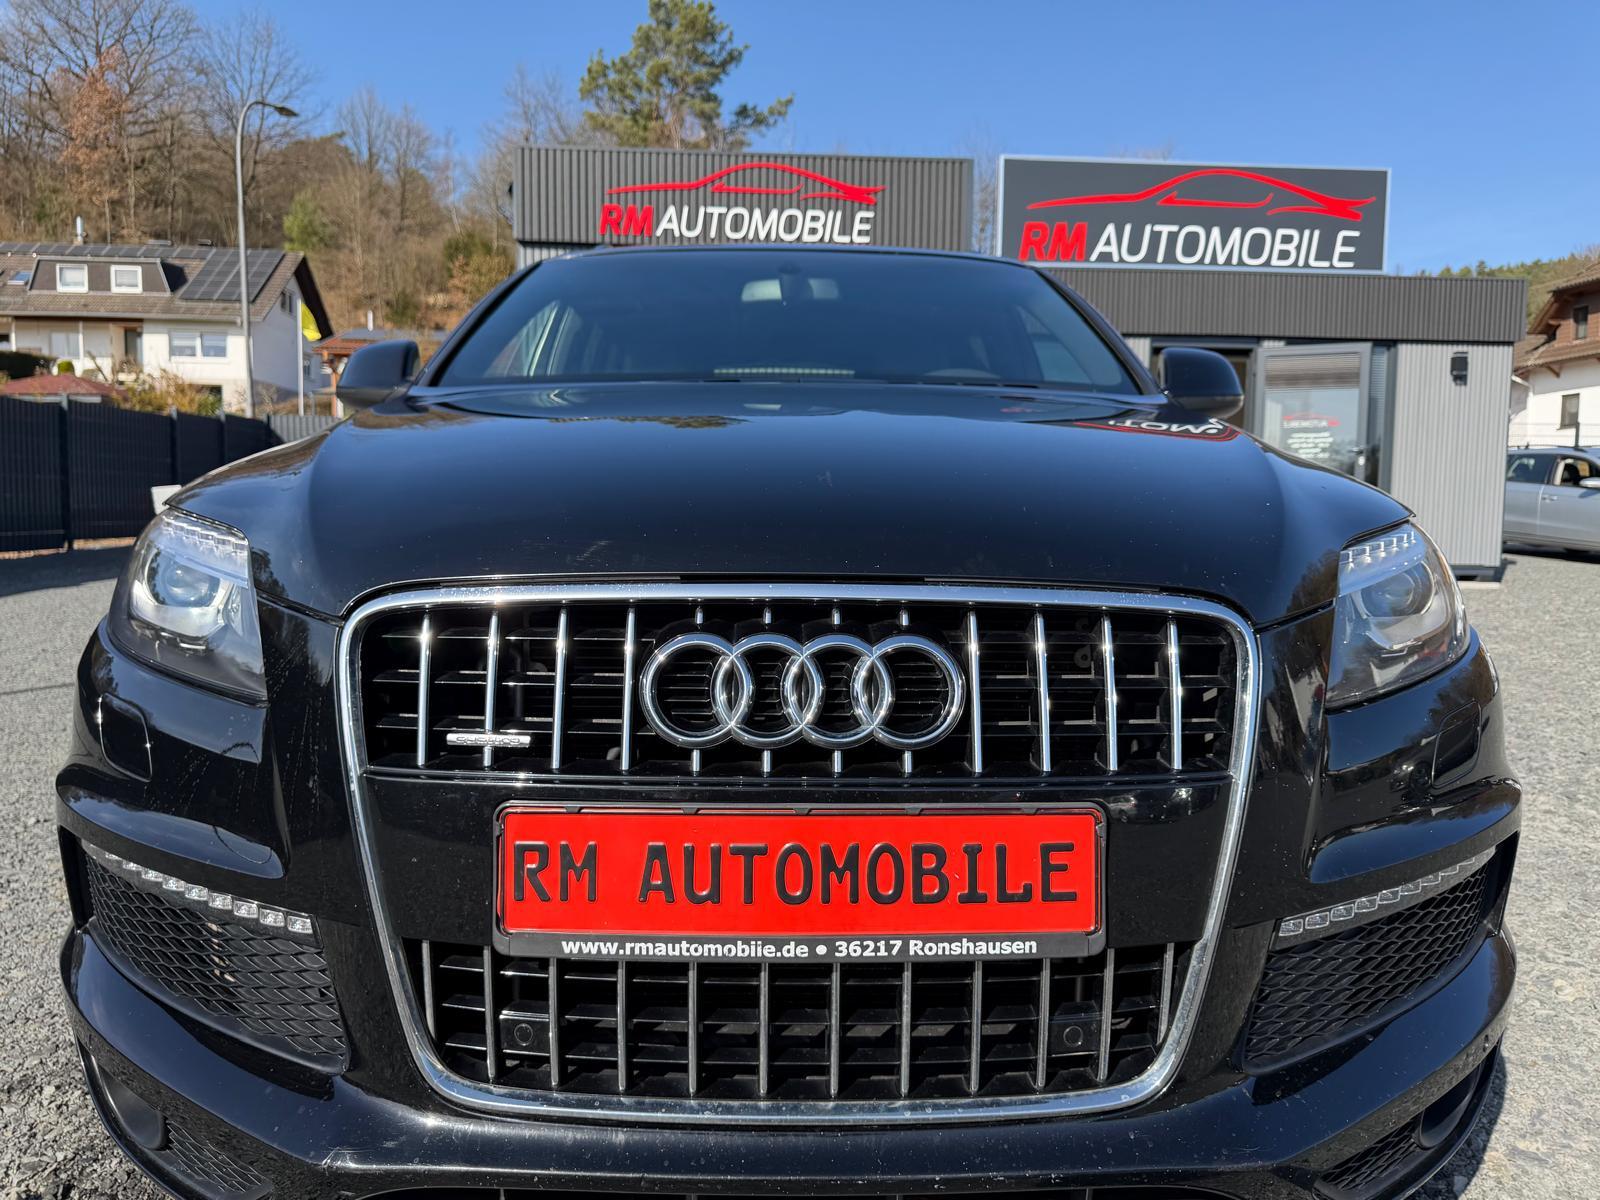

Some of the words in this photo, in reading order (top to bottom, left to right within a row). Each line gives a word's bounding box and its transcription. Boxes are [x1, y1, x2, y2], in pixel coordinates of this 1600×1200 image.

[600, 203, 654, 238] RM
[655, 204, 876, 244] AUTOMOBILE
[1018, 221, 1089, 263] RM
[1089, 222, 1361, 268] AUTOMOBILE
[513, 840, 598, 902] RM
[637, 842, 1078, 906] AUTOMOBILE
[834, 940, 903, 957] 36217
[908, 938, 1038, 956] Ronshausen
